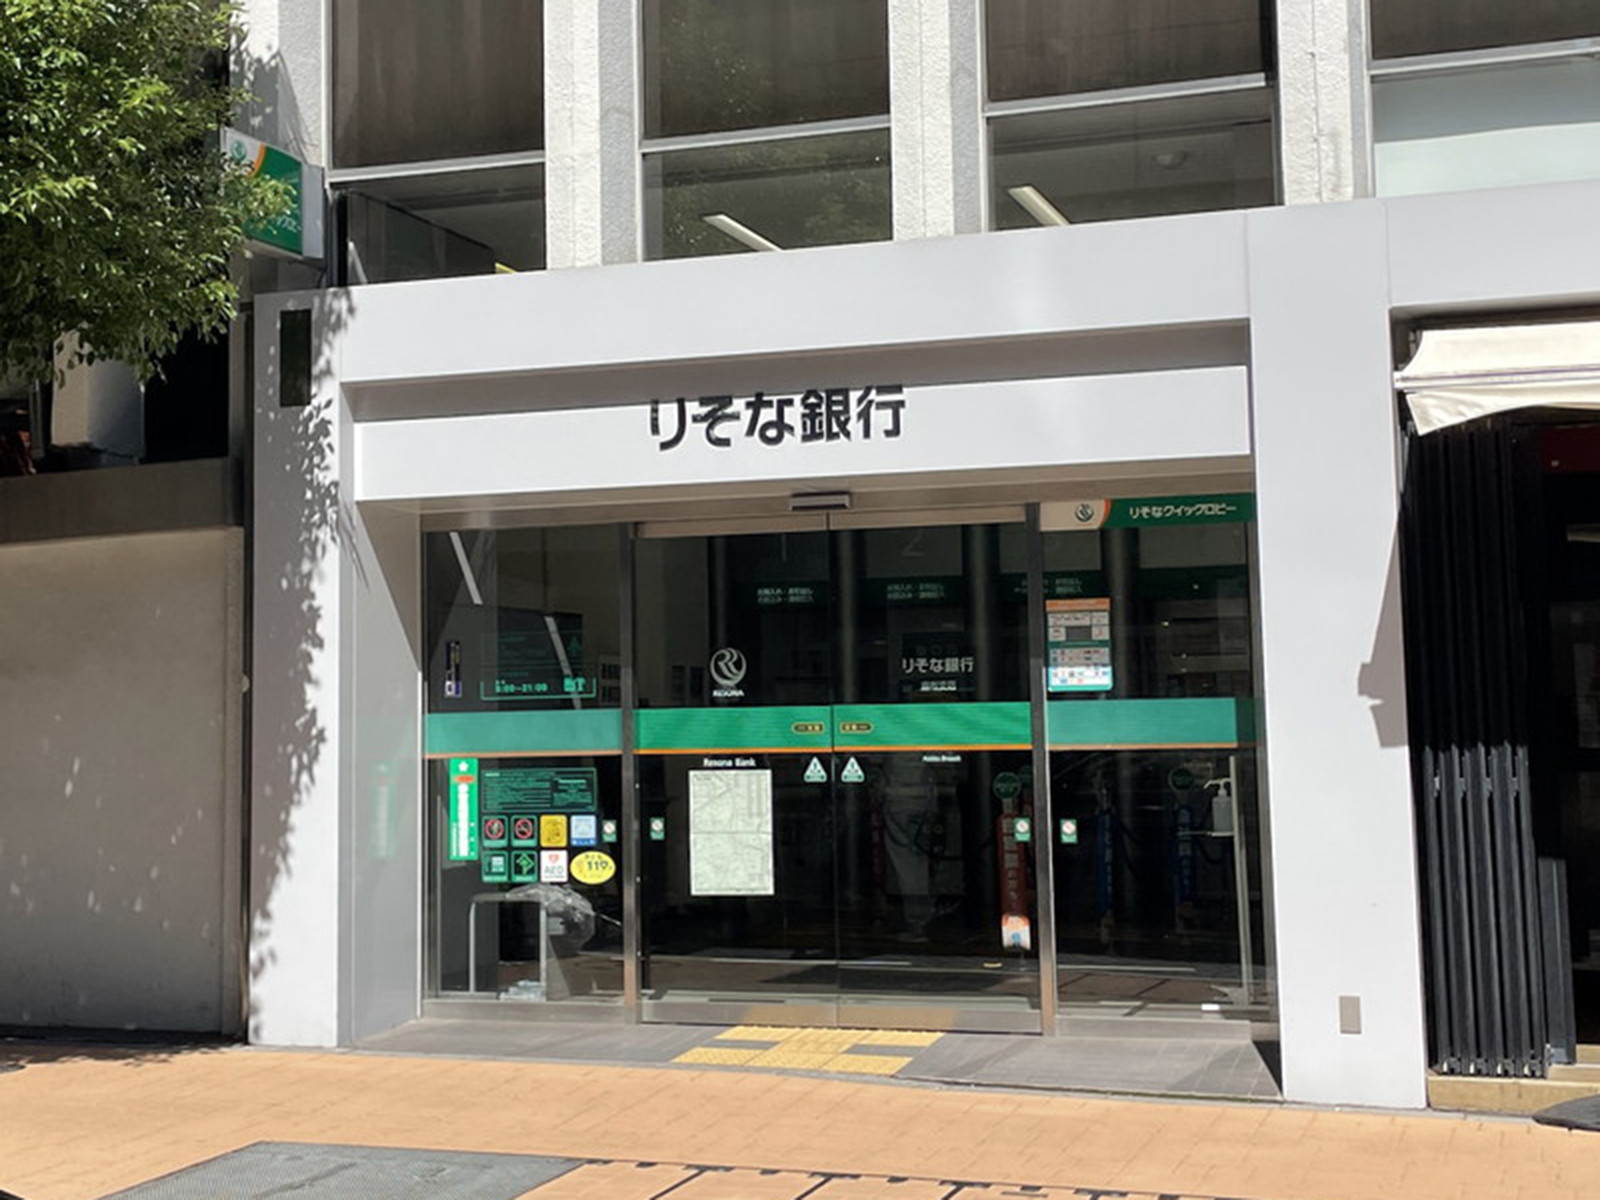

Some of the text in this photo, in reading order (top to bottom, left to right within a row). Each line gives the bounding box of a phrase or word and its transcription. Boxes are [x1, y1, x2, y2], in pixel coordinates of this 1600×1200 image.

[650, 384, 905, 452] りそな銀行
[902, 657, 974, 673] りそな銀行
